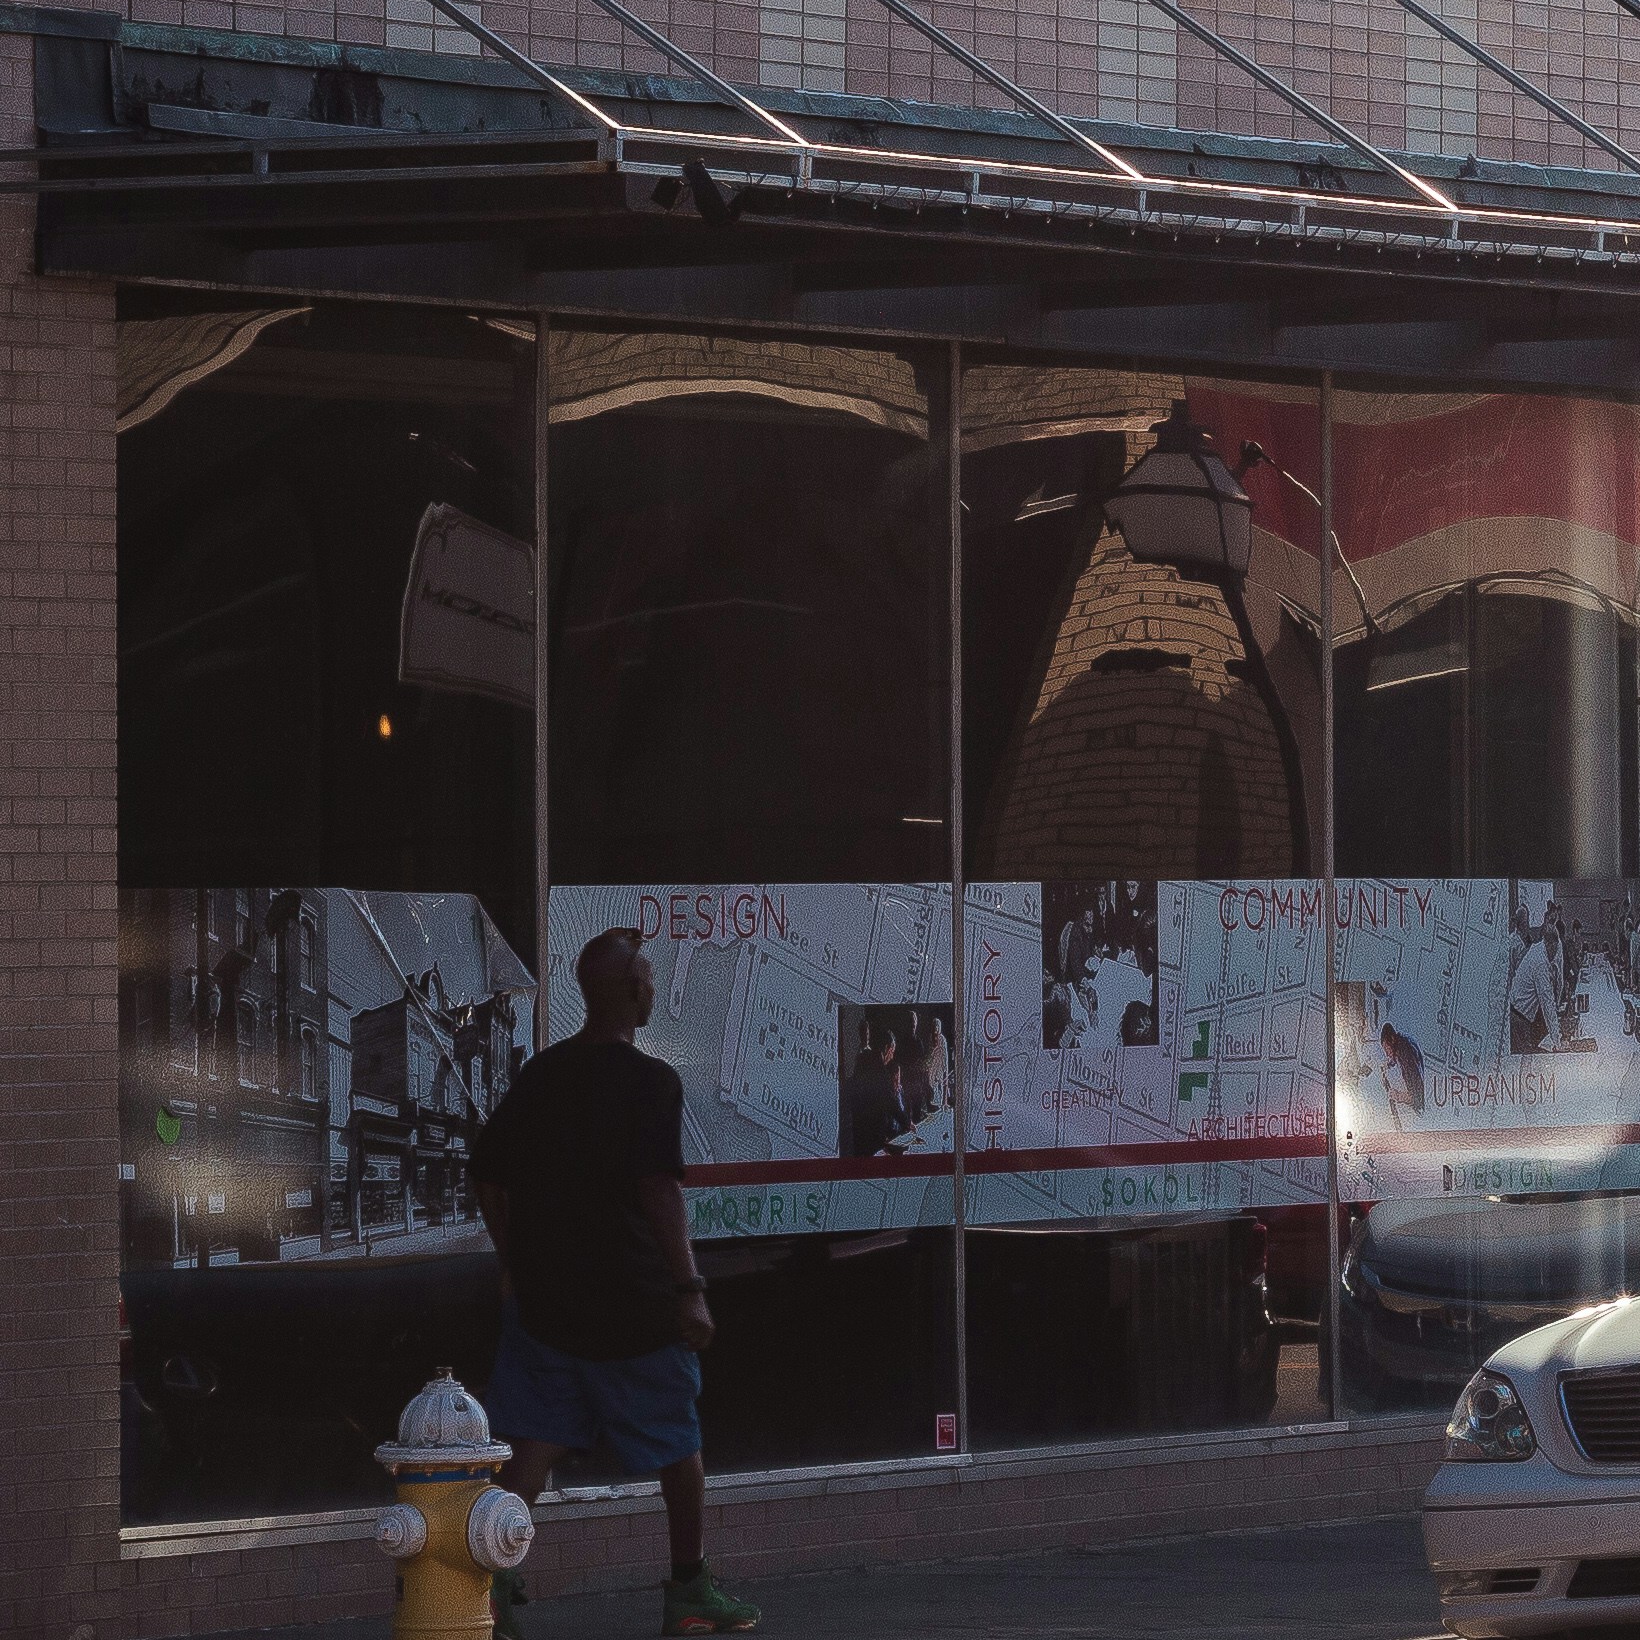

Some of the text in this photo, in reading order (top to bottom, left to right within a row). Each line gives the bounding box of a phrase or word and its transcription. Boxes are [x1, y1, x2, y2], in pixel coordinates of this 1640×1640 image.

[638, 893, 786, 940] DESIGN
[1219, 886, 1432, 932] COMMUNITY
[983, 939, 1003, 1150] HISTORY
[1225, 1033, 1256, 1055] Reid
[1041, 1087, 1124, 1110] CREATIVITY
[1433, 1072, 1557, 1108] URBANISM
[1187, 1108, 1326, 1141] ARCHITECTURE
[1101, 1175, 1199, 1209] SOKOL
[692, 1192, 822, 1231] MORRIS
